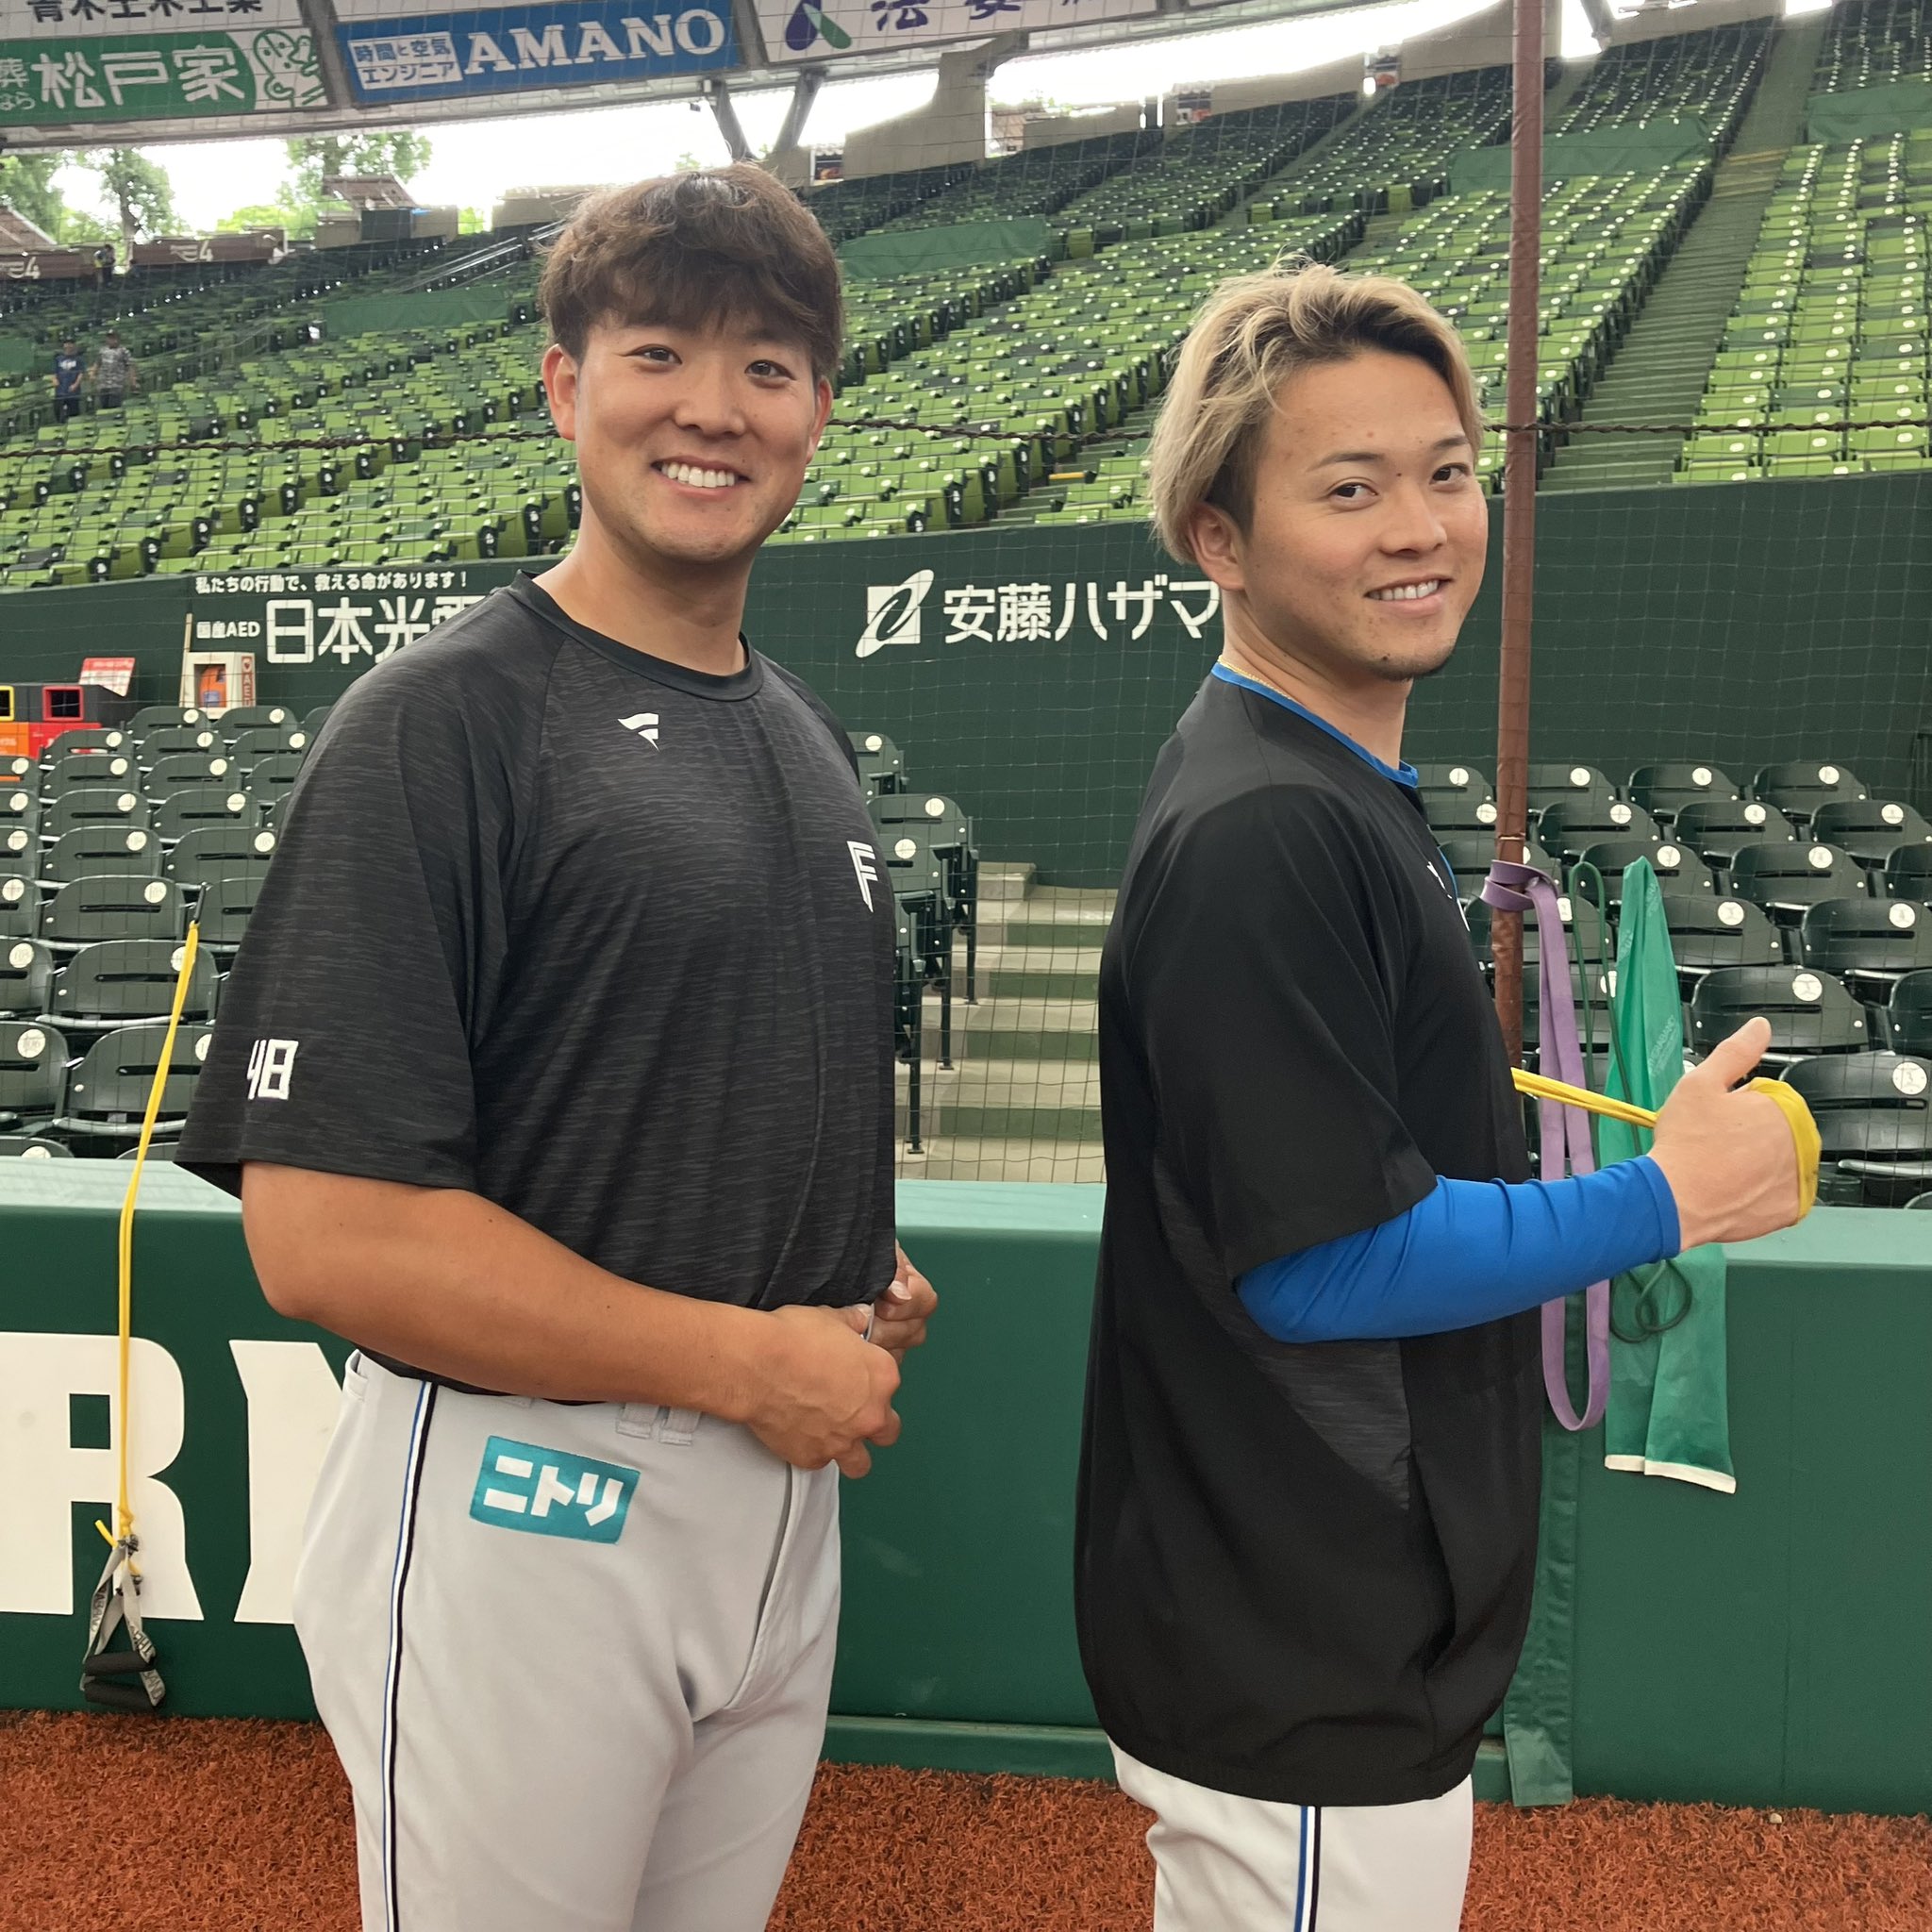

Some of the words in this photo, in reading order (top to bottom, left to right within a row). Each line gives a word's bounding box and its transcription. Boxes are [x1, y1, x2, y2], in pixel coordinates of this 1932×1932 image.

[353, 38, 452, 63] 時間と空気
[362, 62, 454, 83] エンジニア
[463, 8, 725, 75] AMANO
[30, 44, 245, 109] 松戸家
[943, 574, 1220, 644] 安藤ハザマ
[246, 1039, 299, 1101] 48
[483, 1455, 625, 1527] ニトリ
